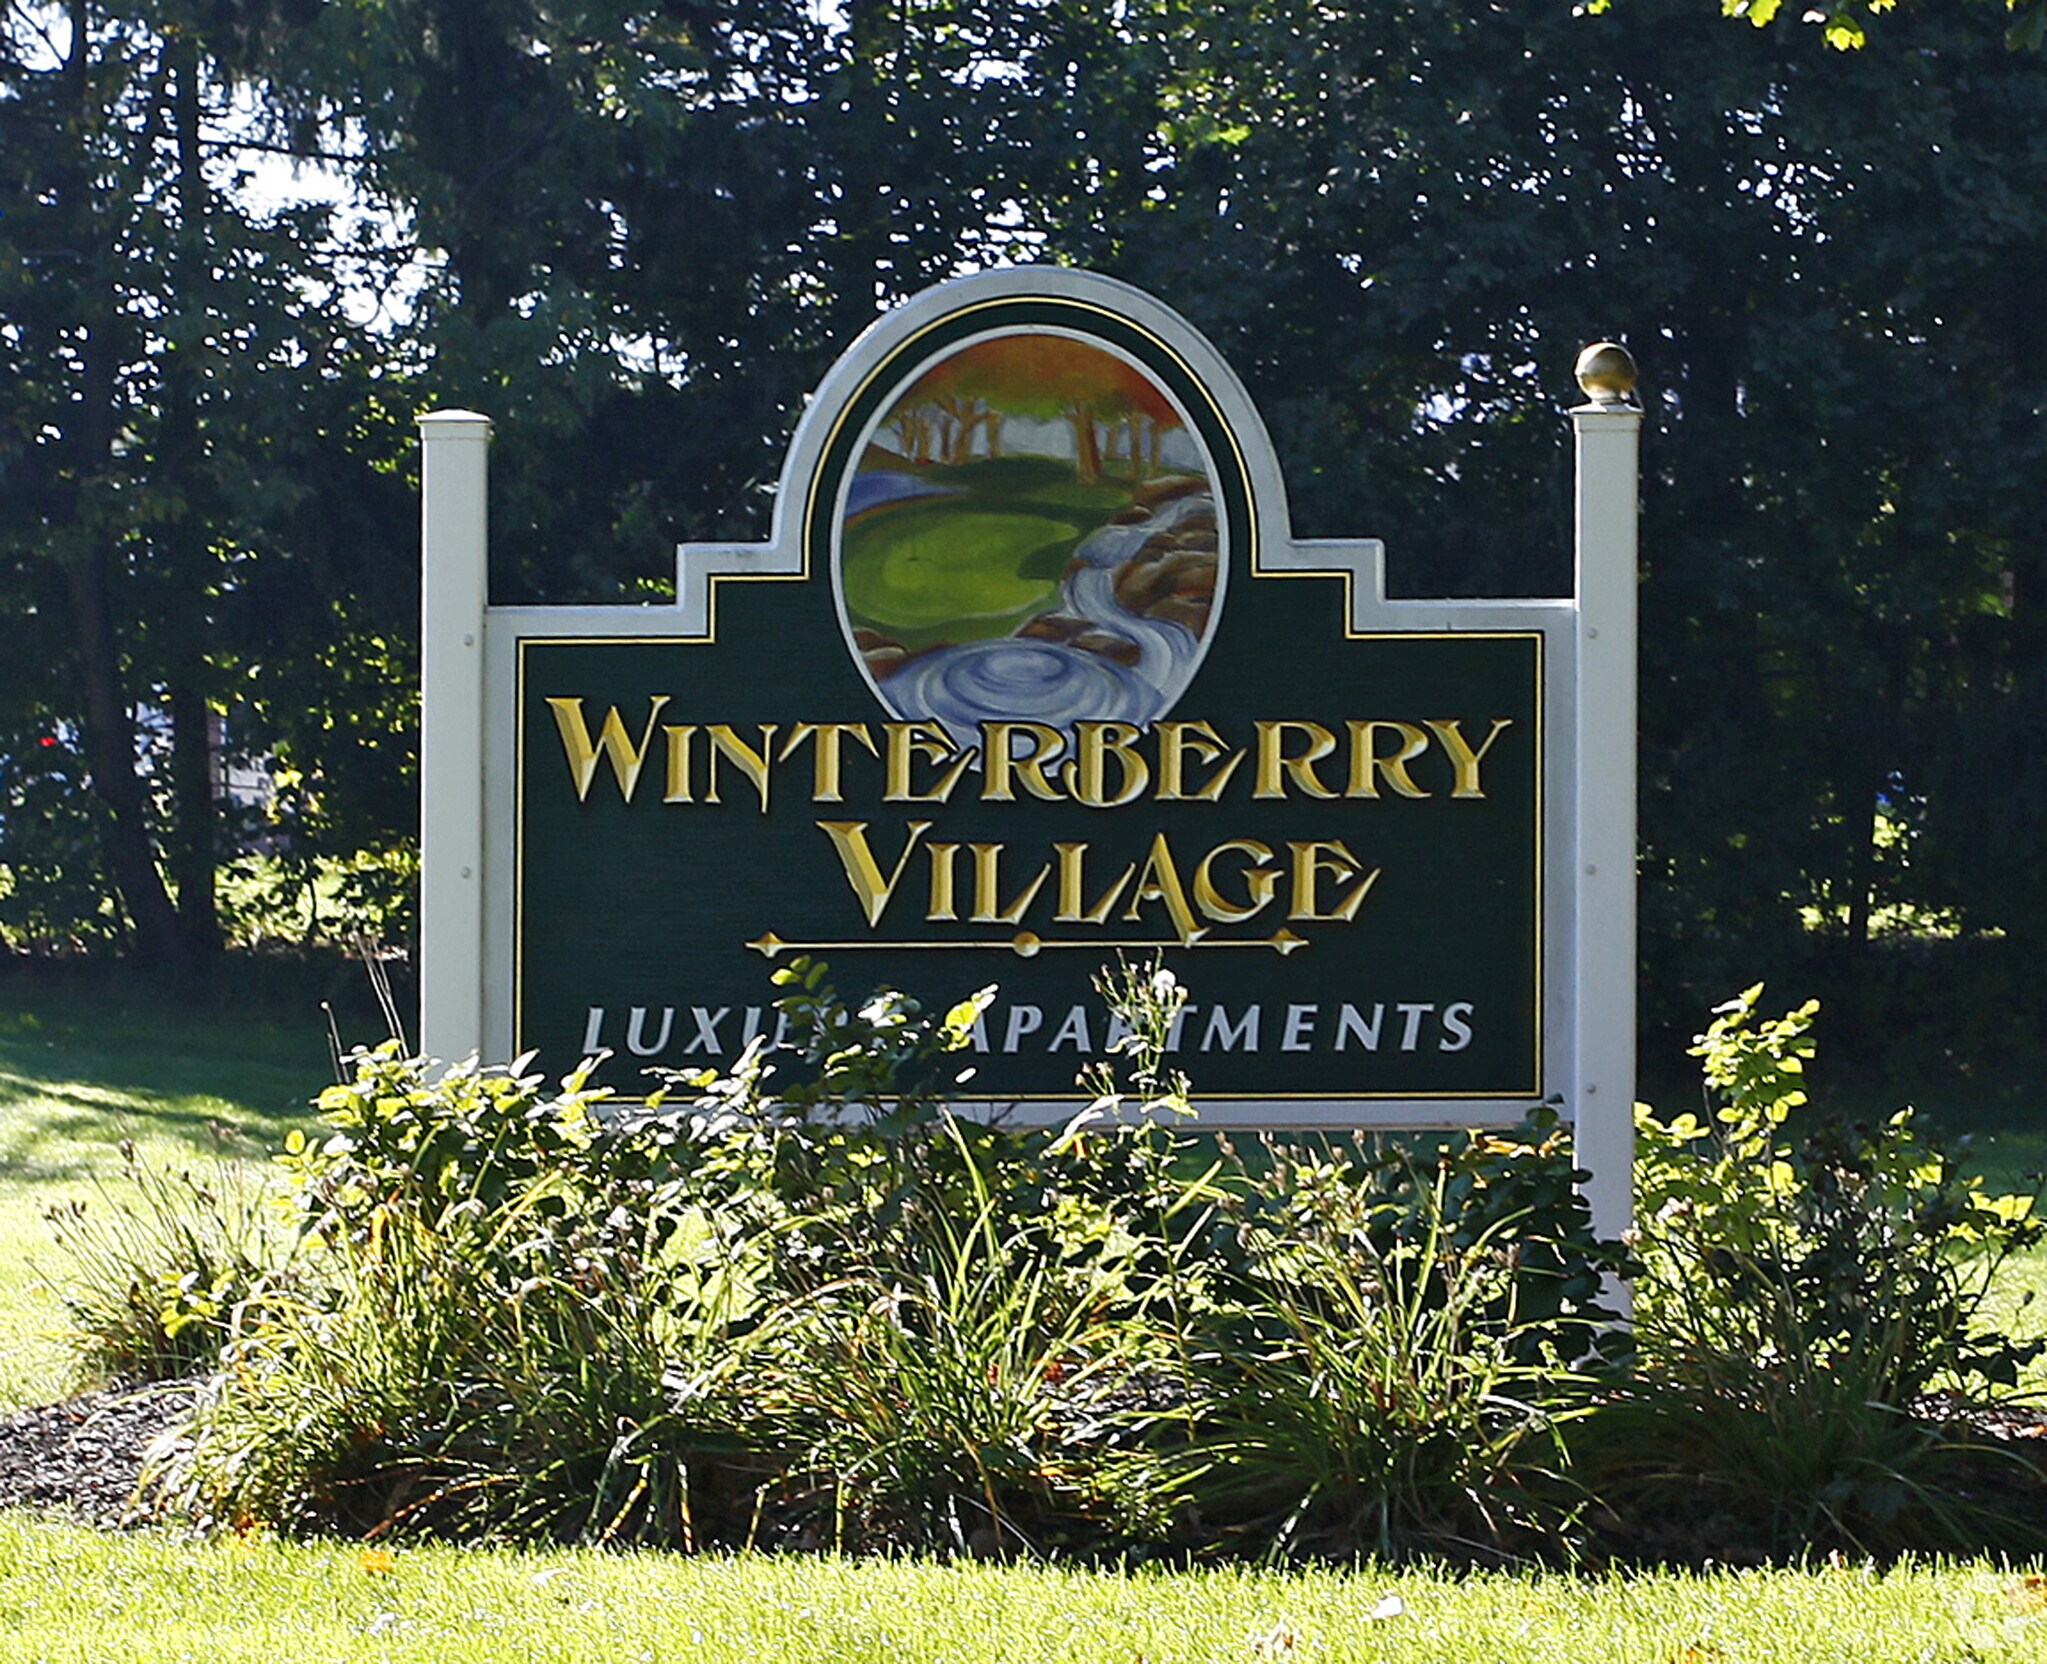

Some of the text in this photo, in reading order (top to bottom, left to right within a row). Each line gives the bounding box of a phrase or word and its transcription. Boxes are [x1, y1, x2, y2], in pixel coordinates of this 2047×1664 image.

[544, 695, 1513, 813] WINTERBERRY
[815, 820, 1381, 948] VILLAGE
[582, 1005, 906, 1057] LUXU
